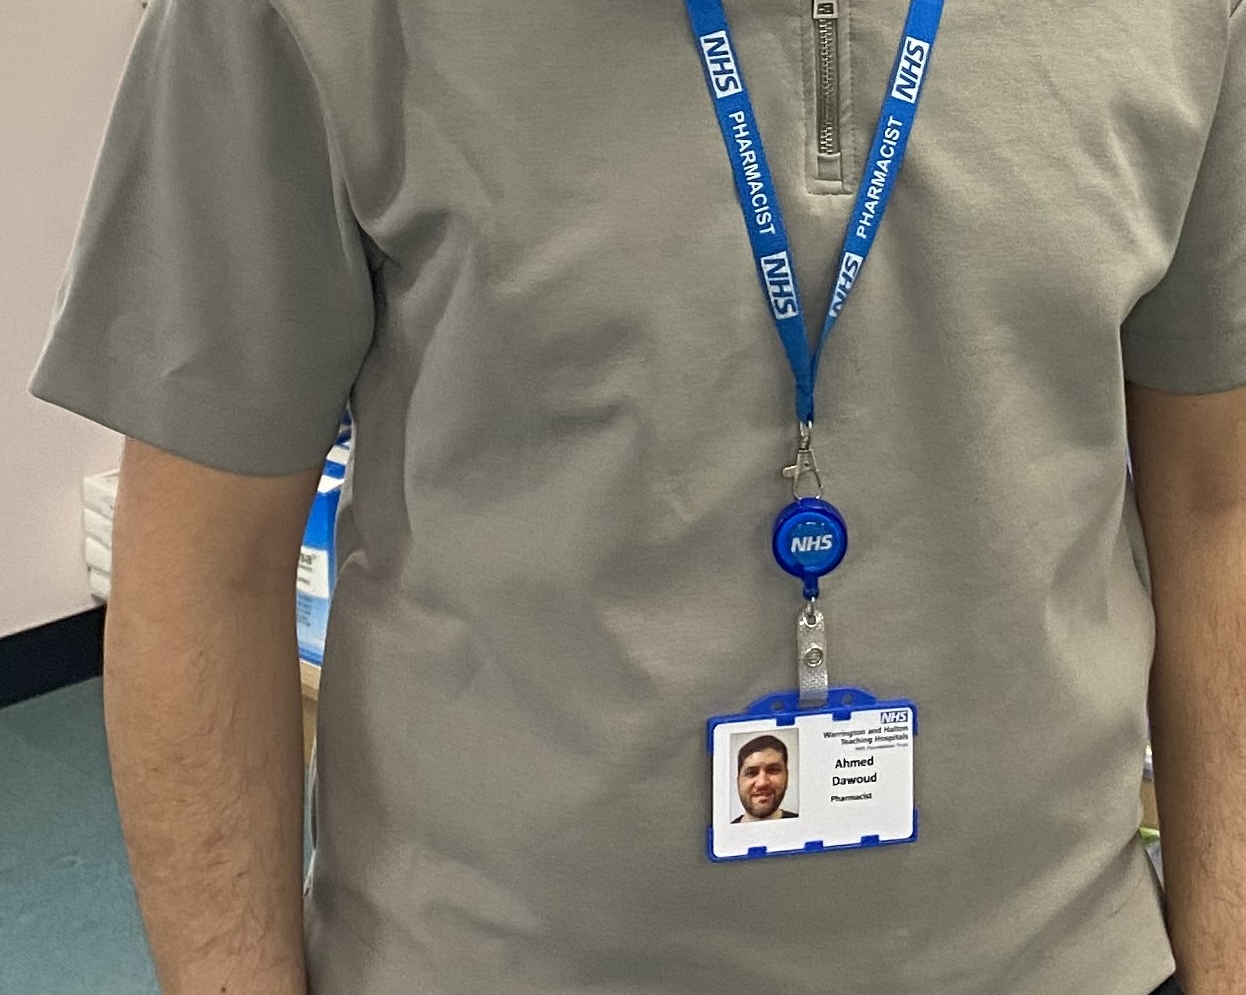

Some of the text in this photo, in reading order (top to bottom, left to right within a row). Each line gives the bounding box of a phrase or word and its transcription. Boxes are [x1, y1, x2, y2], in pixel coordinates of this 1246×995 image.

[703, 34, 740, 95] NHS
[894, 40, 927, 101] NHS
[729, 110, 775, 237] PHARMACIST
[856, 117, 903, 240] PHARMACIST
[763, 258, 798, 315] NHS
[831, 255, 858, 314] NHS
[790, 535, 832, 553] NHS
[881, 711, 907, 724] NHS
[875, 733, 908, 742] Hospitals
[832, 773, 877, 786] Dawoud
[835, 756, 874, 769] Ahmed
[831, 792, 873, 802] Pharmacist
